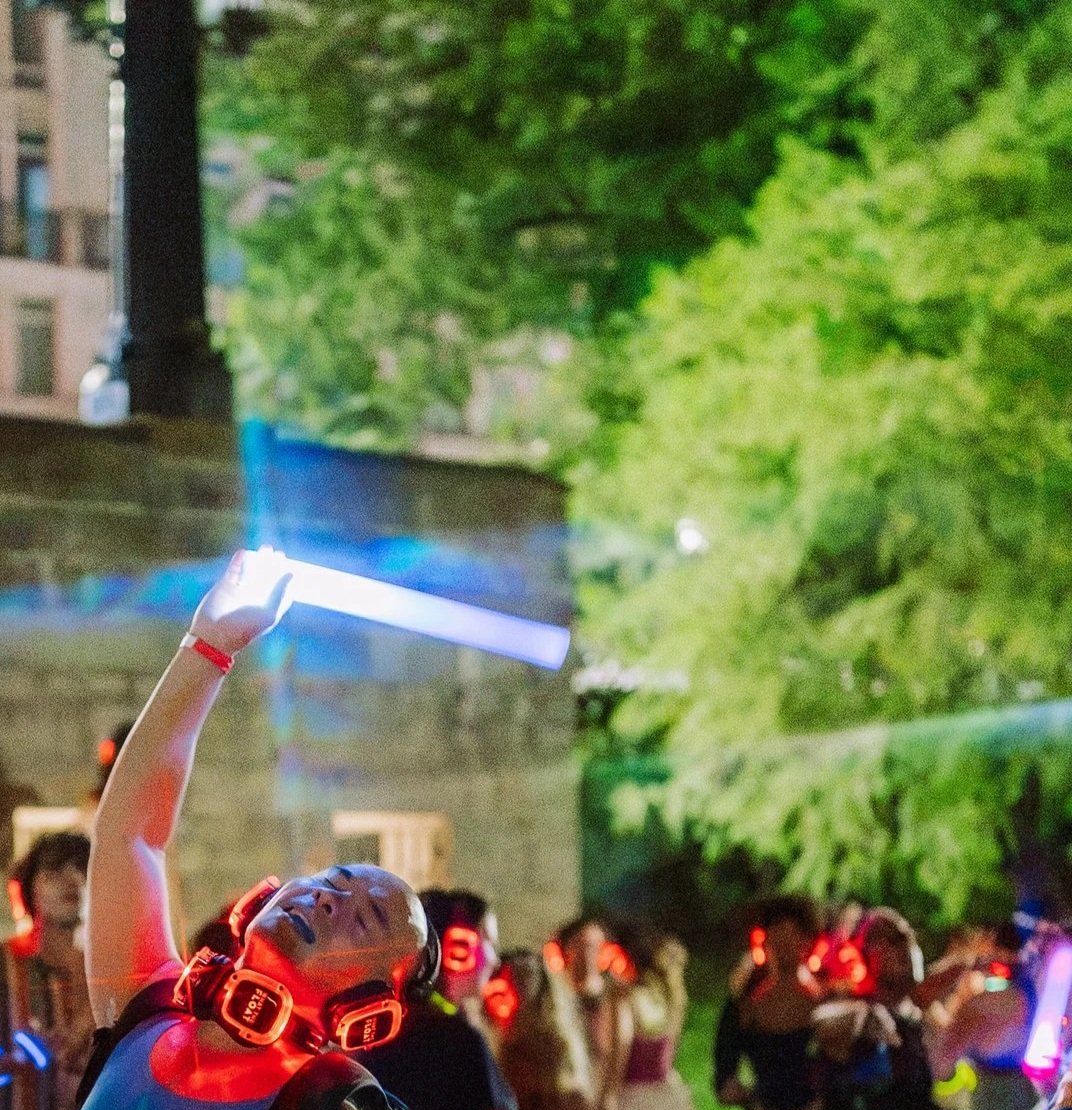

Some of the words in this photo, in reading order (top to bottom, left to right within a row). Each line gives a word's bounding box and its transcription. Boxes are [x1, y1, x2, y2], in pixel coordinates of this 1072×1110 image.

[242, 988, 263, 1022] FLOAT
[256, 992, 268, 1010] WHAT
[363, 1018, 372, 1042] FLOAT
